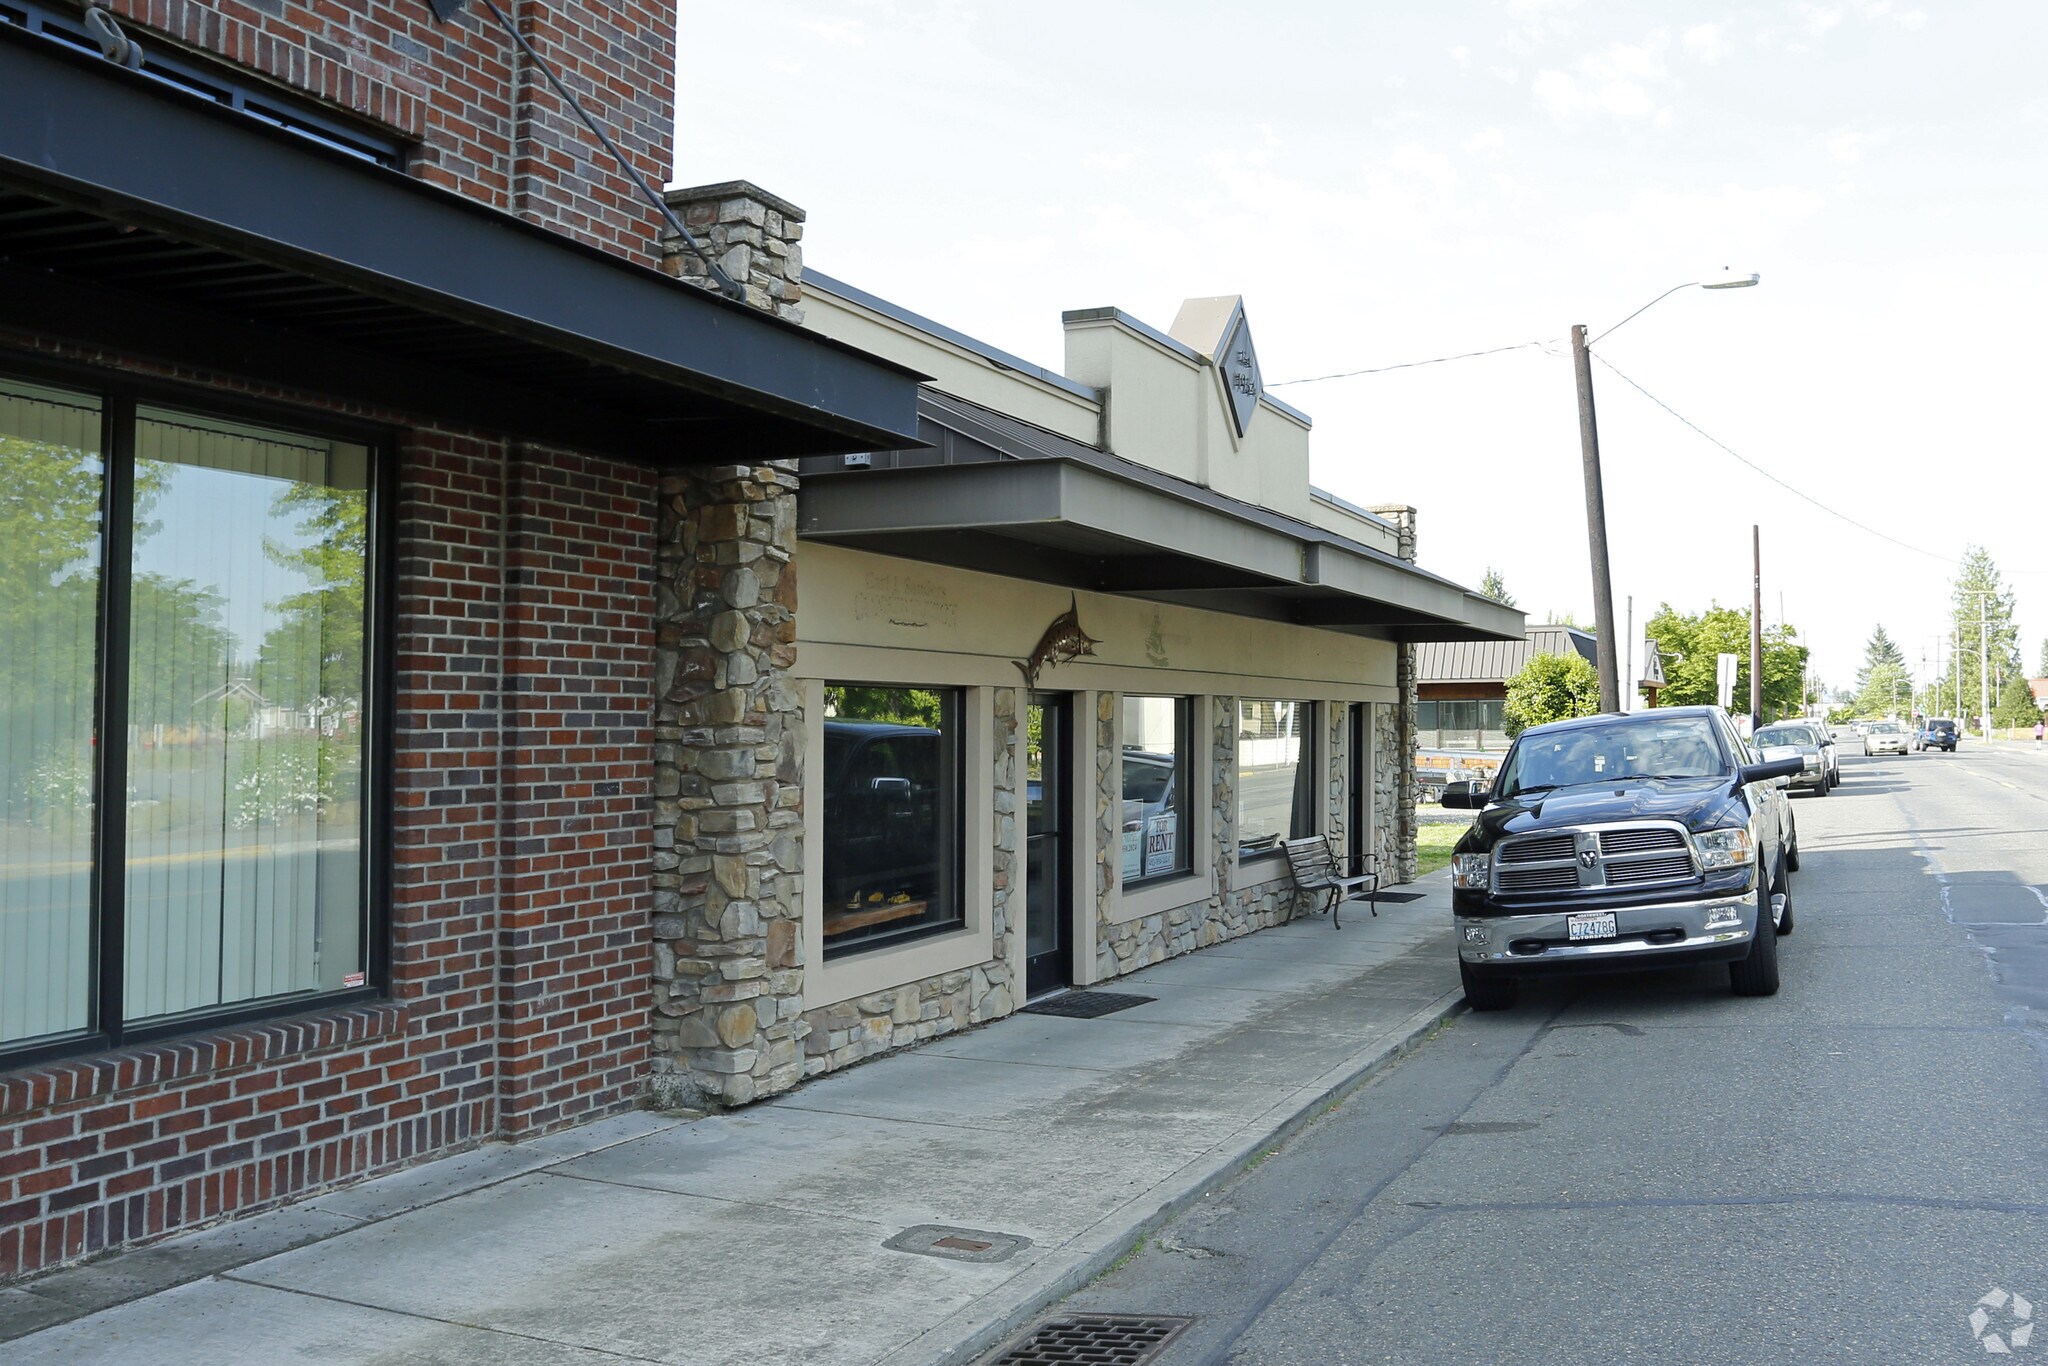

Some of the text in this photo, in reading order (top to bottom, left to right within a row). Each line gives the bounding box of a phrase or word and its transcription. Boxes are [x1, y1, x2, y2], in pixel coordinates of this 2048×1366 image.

[1155, 820, 1168, 833] FOR
[1149, 833, 1174, 853] RENT
[1569, 933, 1617, 941] MOTORSPORT
